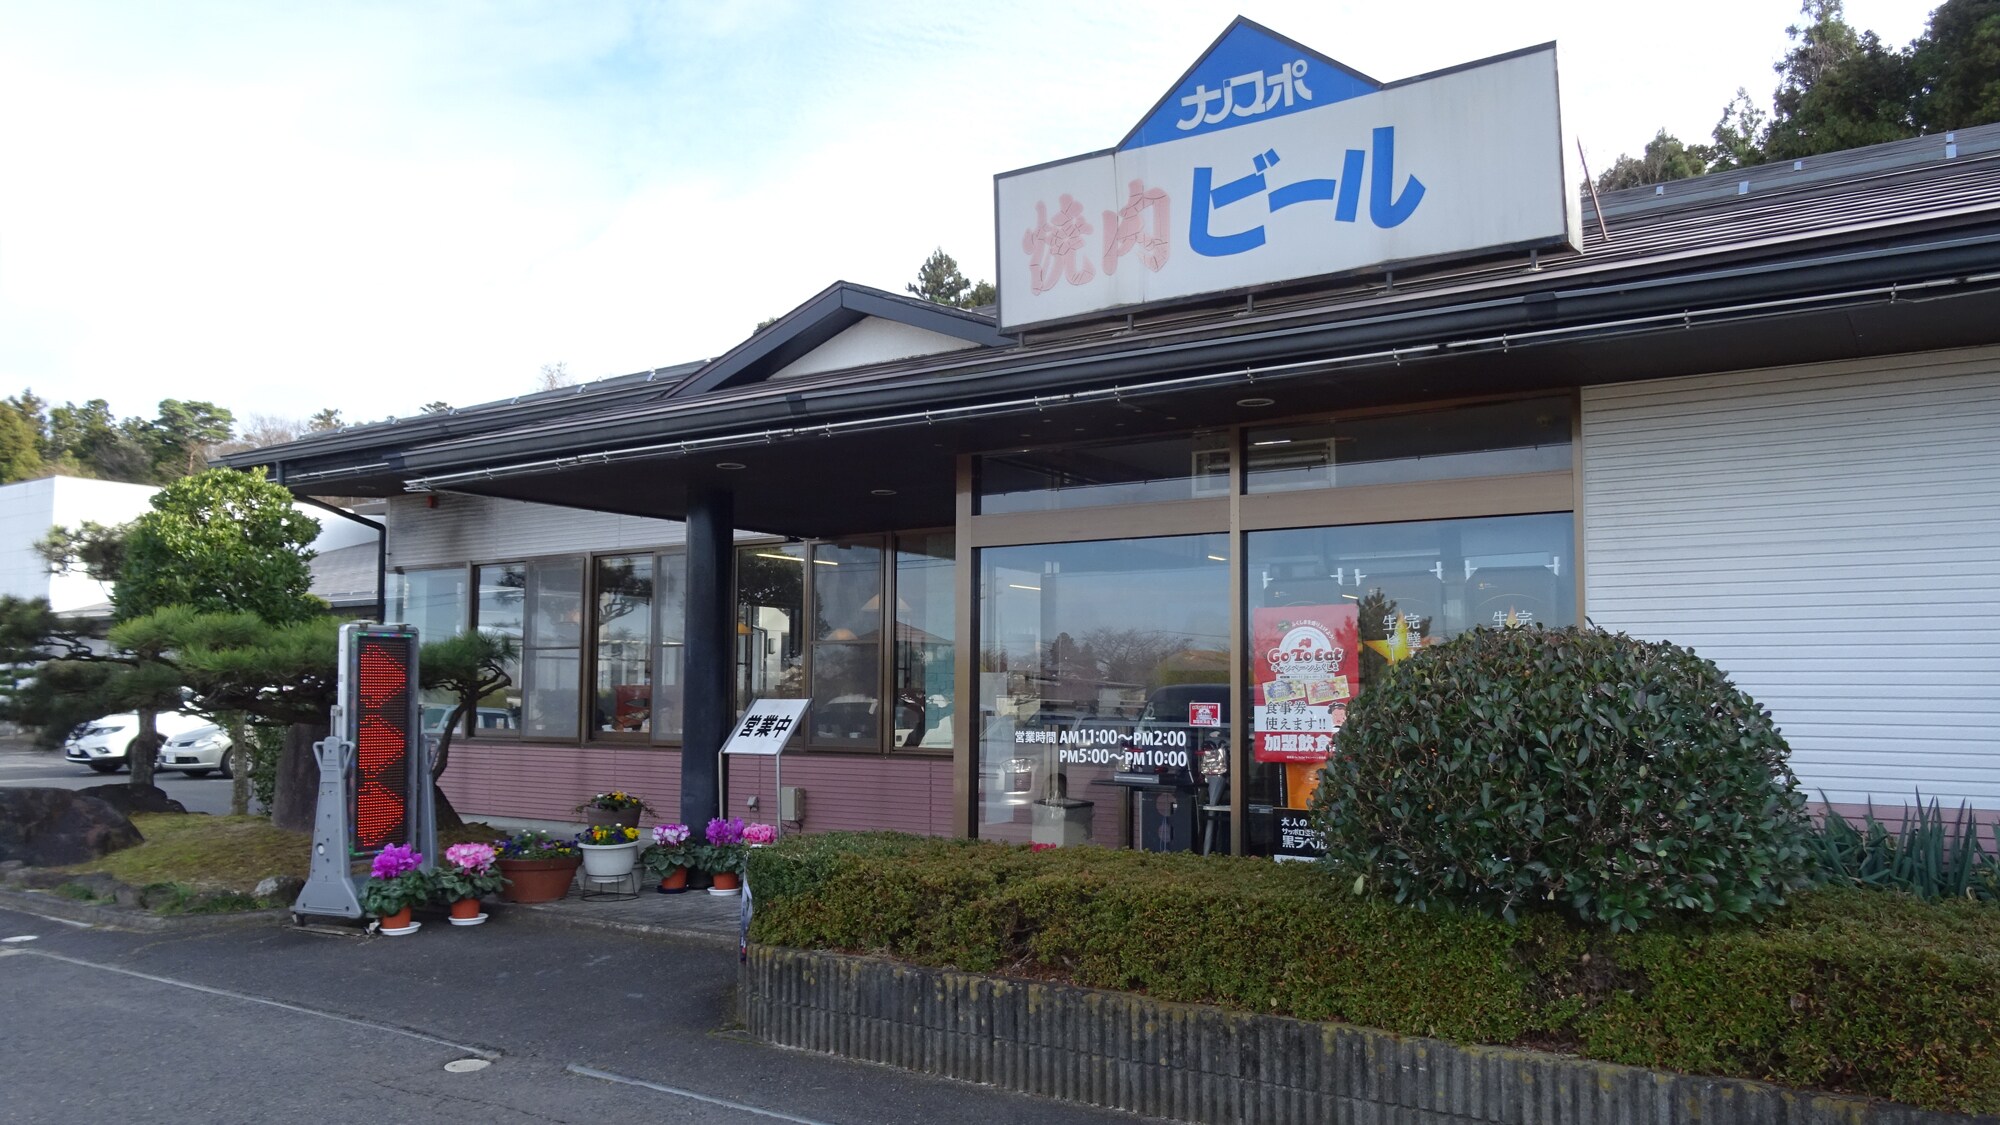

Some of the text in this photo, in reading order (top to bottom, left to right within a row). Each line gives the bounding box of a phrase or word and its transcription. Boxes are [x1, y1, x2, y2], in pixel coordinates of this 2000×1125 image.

[1189, 126, 1426, 257] ビール
[739, 715, 792, 738] 営業中
[1015, 731, 1056, 744] 営業時間
[1264, 733, 1336, 752] 加盟飲食
